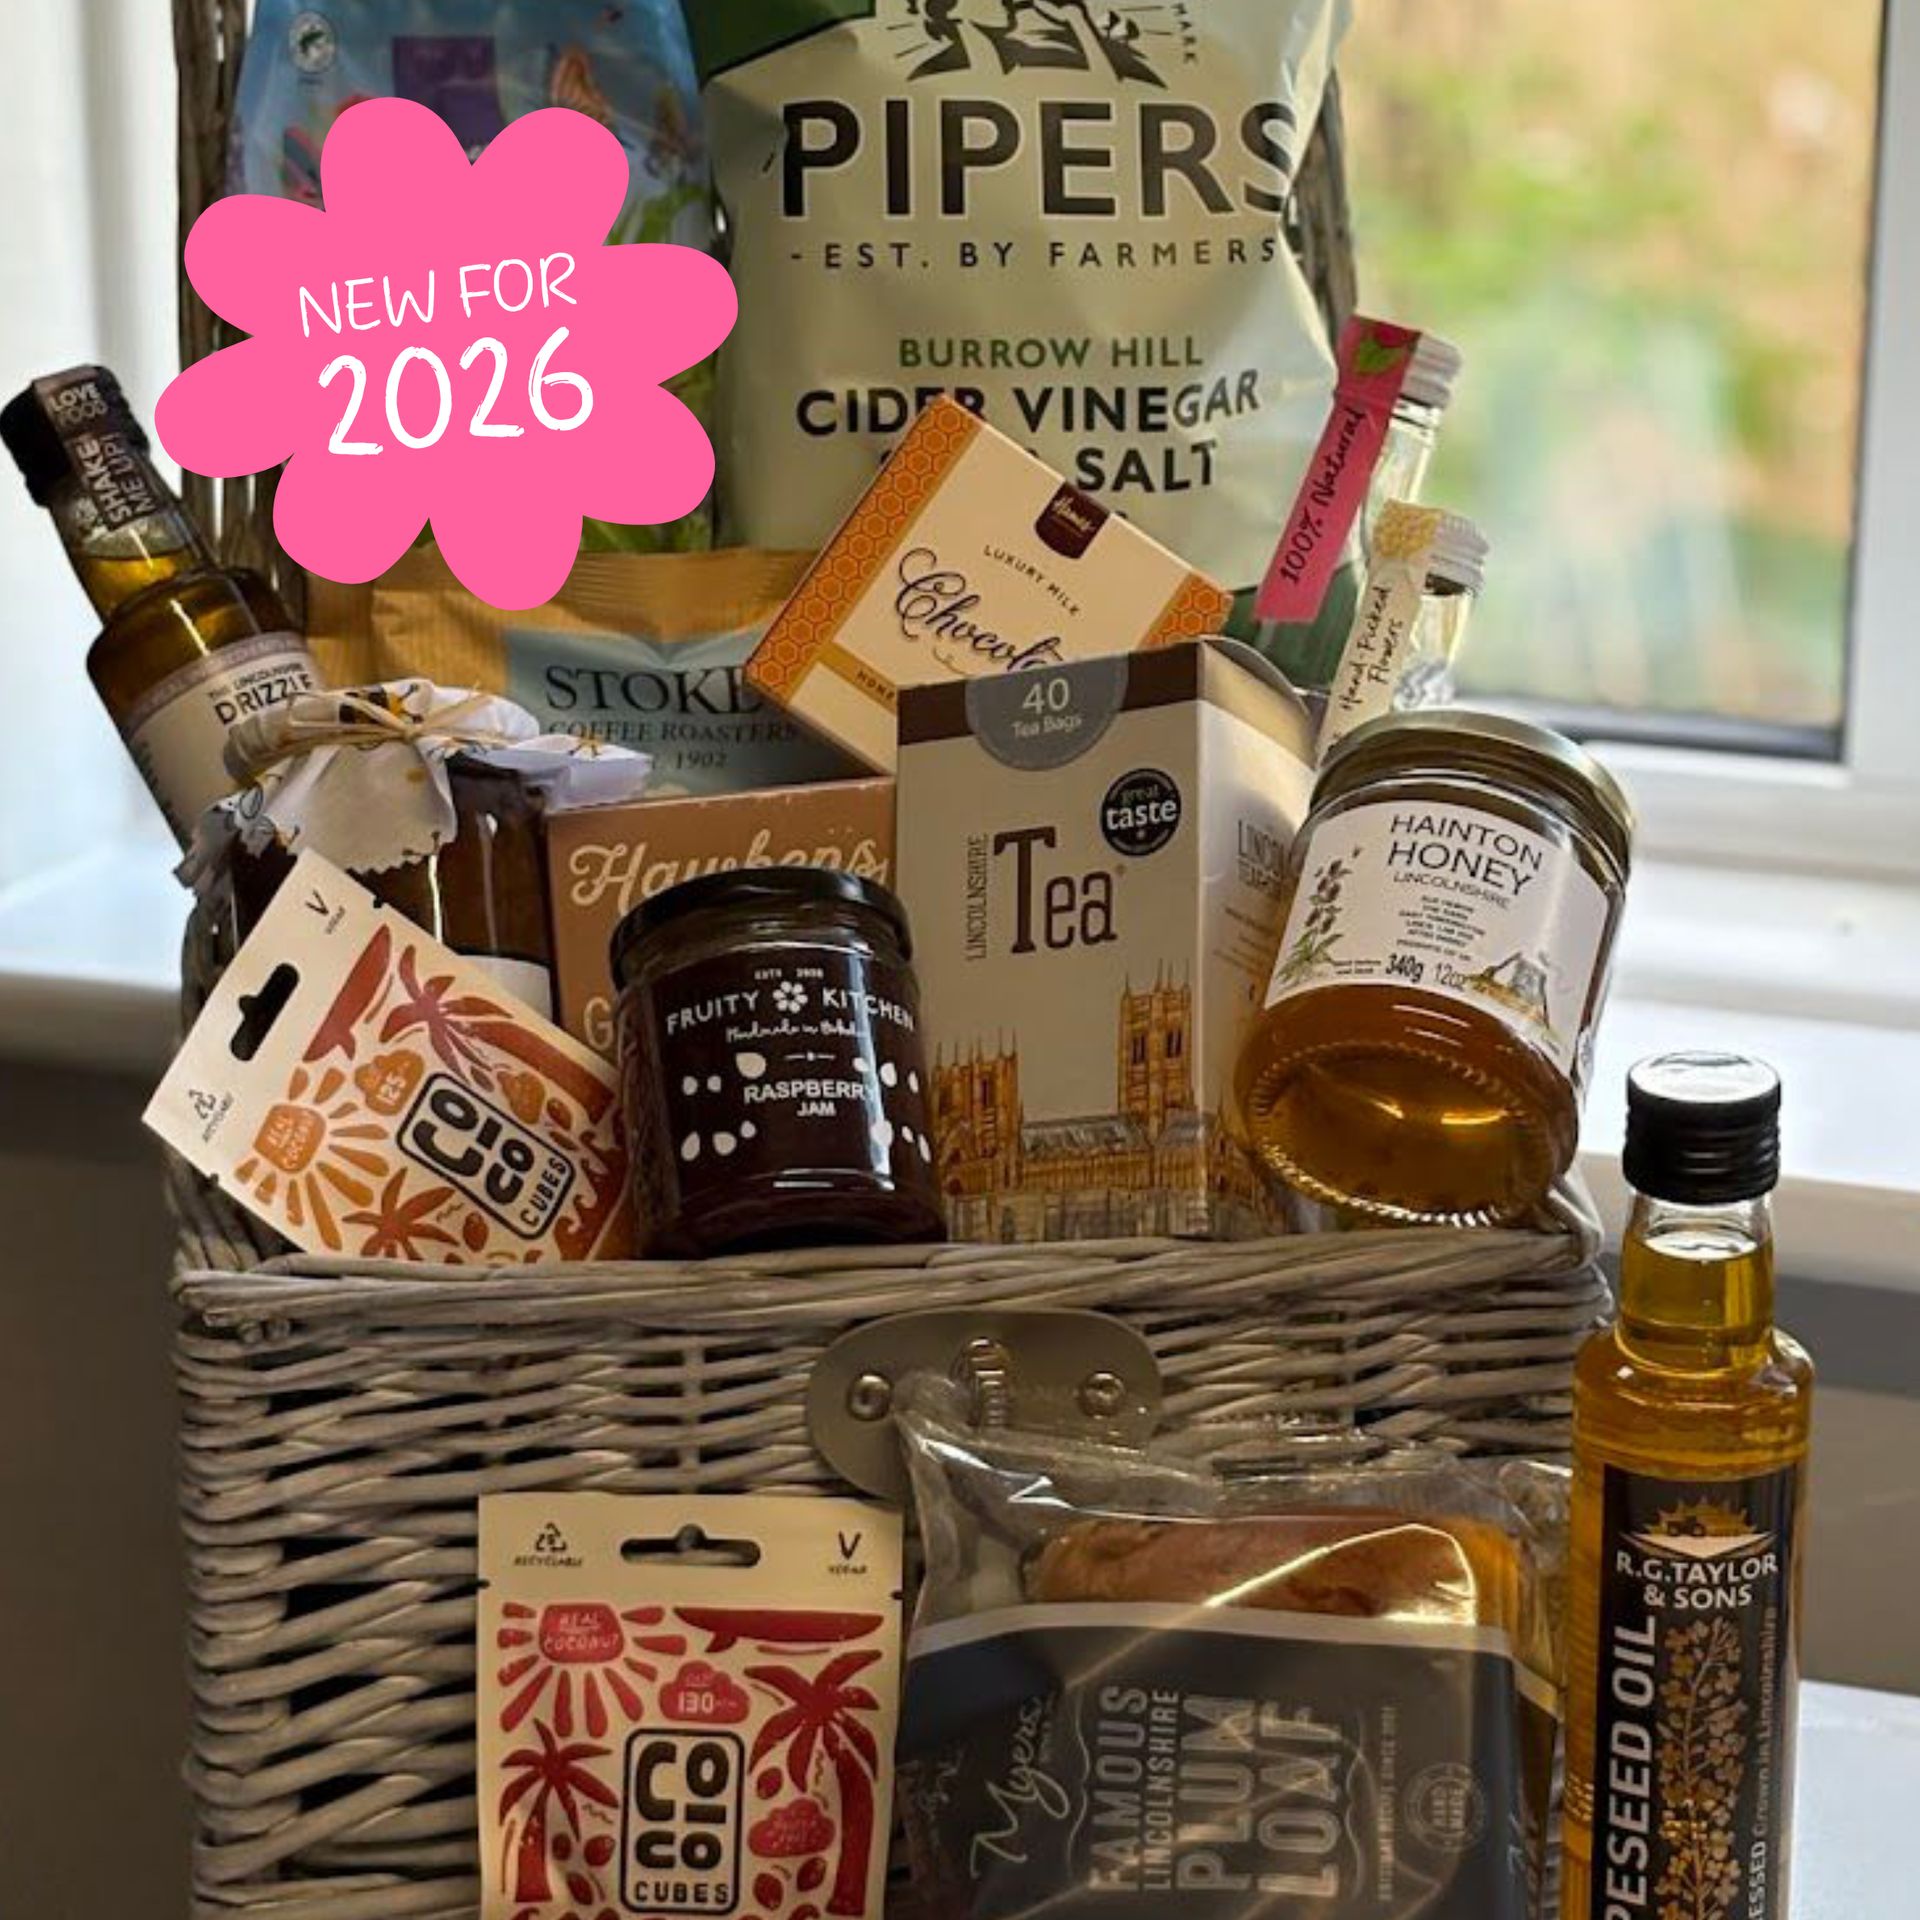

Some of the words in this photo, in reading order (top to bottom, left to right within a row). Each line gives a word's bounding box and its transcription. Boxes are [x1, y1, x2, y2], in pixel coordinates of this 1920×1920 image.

[782, 99, 1296, 217] PIPERS
[825, 242, 930, 268] EST.
[960, 242, 1013, 267] BY
[1049, 237, 1277, 267] FARMERS
[900, 338, 1092, 369] BURROW
[1111, 336, 1204, 367] HILL
[51, 382, 100, 411] LOVE
[1012, 368, 1261, 434] VINEGAR
[75, 437, 133, 523] SHAKE
[1075, 439, 1218, 494] SALT
[1280, 507, 1325, 584] 100%
[1310, 404, 1368, 506] Natural
[982, 544, 1045, 584] LUXURY
[1045, 583, 1082, 617] MILK
[895, 547, 1064, 673] Chocol
[1367, 617, 1403, 685] Flowers
[546, 665, 762, 715] STOKE
[1021, 677, 1070, 715] 40
[1010, 720, 1041, 739] Tea
[1042, 714, 1083, 734] Bags
[1106, 799, 1178, 831] taste
[1390, 814, 1543, 872] HAINTON
[993, 825, 1119, 955] Tea
[1387, 840, 1534, 897] HONEY
[666, 989, 761, 1036] FRUITY
[821, 986, 915, 1032] KITCHEN
[797, 1101, 836, 1118] JAM
[519, 1156, 567, 1228] CUBES
[1642, 1583, 1667, 1608] &
[1672, 1582, 1753, 1610] SONS
[1611, 1613, 1656, 1708] OIL
[677, 1691, 715, 1714] 130
[1088, 1685, 1148, 1893] FAMOUS
[1143, 1688, 1180, 1892] LINCOLNSHIRE
[1176, 1694, 1256, 1891] PLUM
[1256, 1700, 1343, 1898] LOAF
[633, 1880, 730, 1905] CUBES
